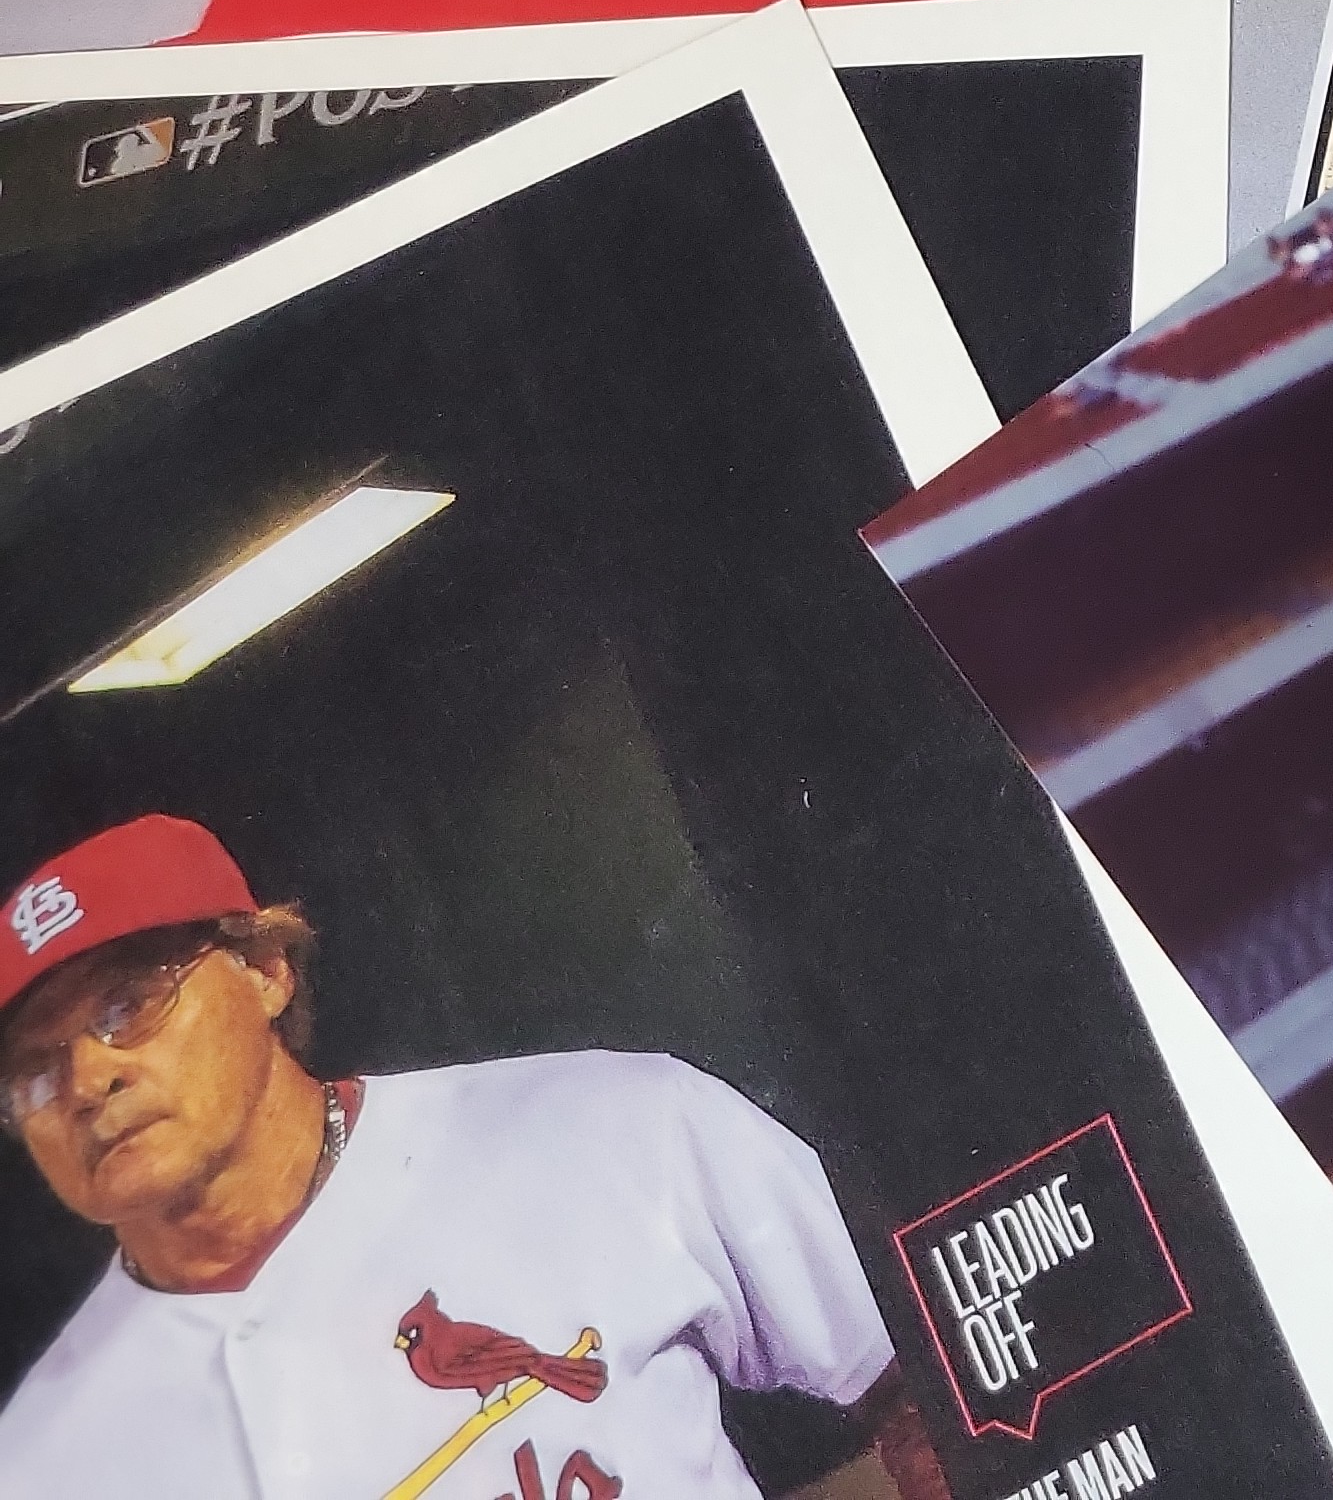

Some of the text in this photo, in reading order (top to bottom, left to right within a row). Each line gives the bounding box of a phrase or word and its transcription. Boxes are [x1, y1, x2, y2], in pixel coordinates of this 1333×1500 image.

[931, 1172, 1096, 1316] LEADING
[962, 1291, 1039, 1392] OFF
[1066, 1423, 1157, 1500] MAN
